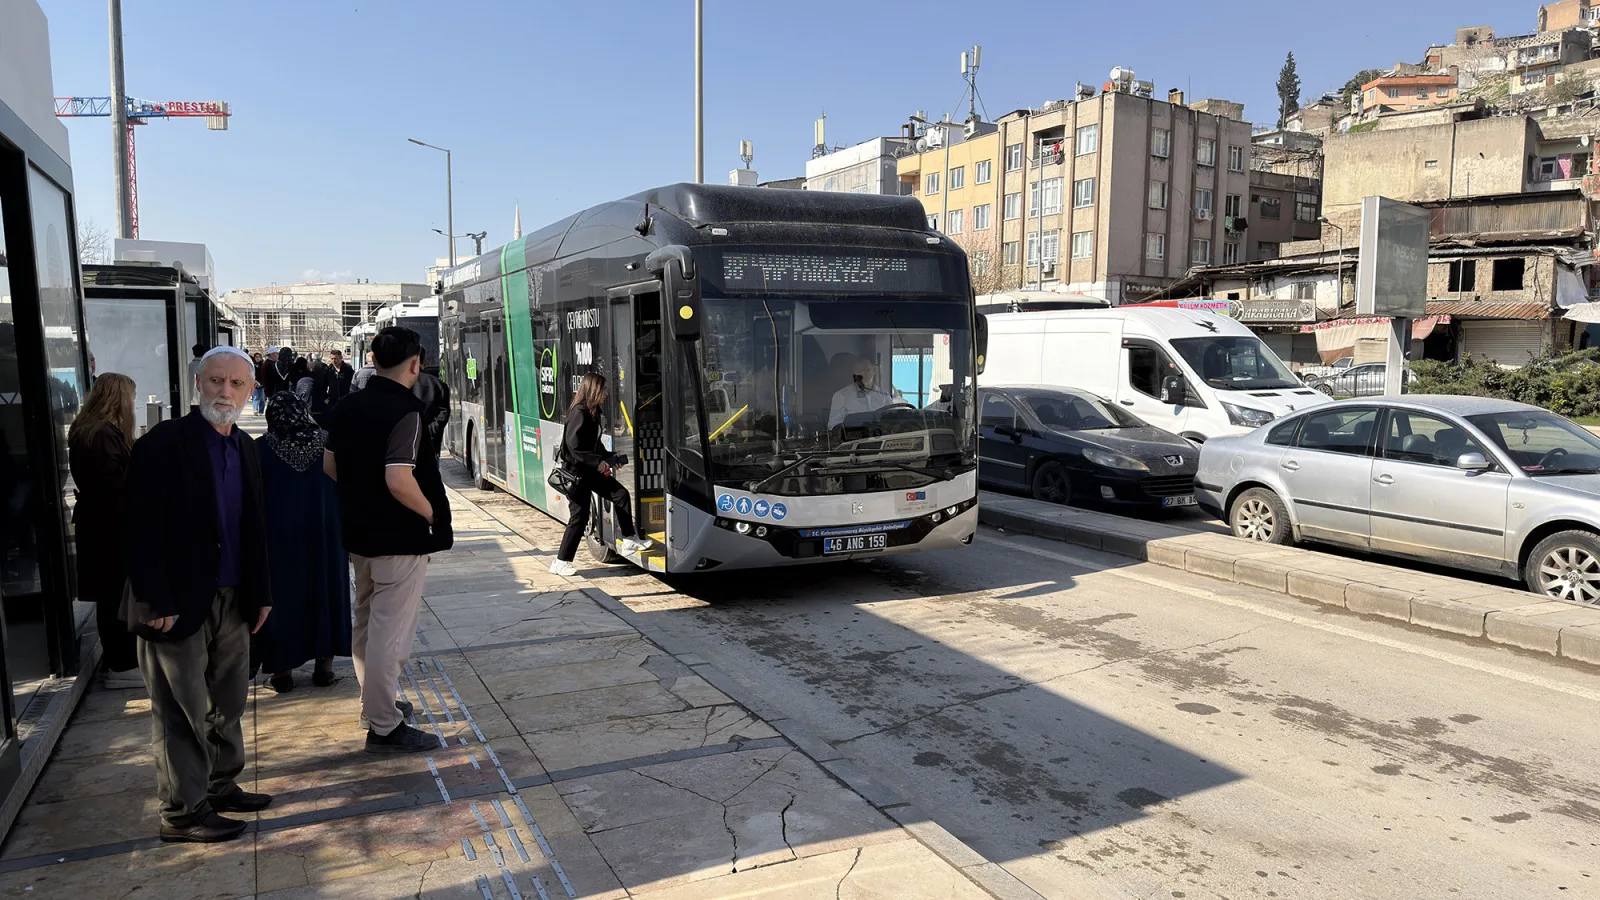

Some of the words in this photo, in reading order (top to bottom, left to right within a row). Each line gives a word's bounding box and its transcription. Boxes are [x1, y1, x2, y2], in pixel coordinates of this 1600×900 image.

[567, 310, 582, 333] ÇEVRE
[582, 308, 599, 328] DOSTU
[575, 341, 593, 365] %100
[1166, 497, 1174, 506] 27
[830, 538, 842, 551] 46
[847, 537, 864, 550] ANG
[868, 535, 885, 548] 159
